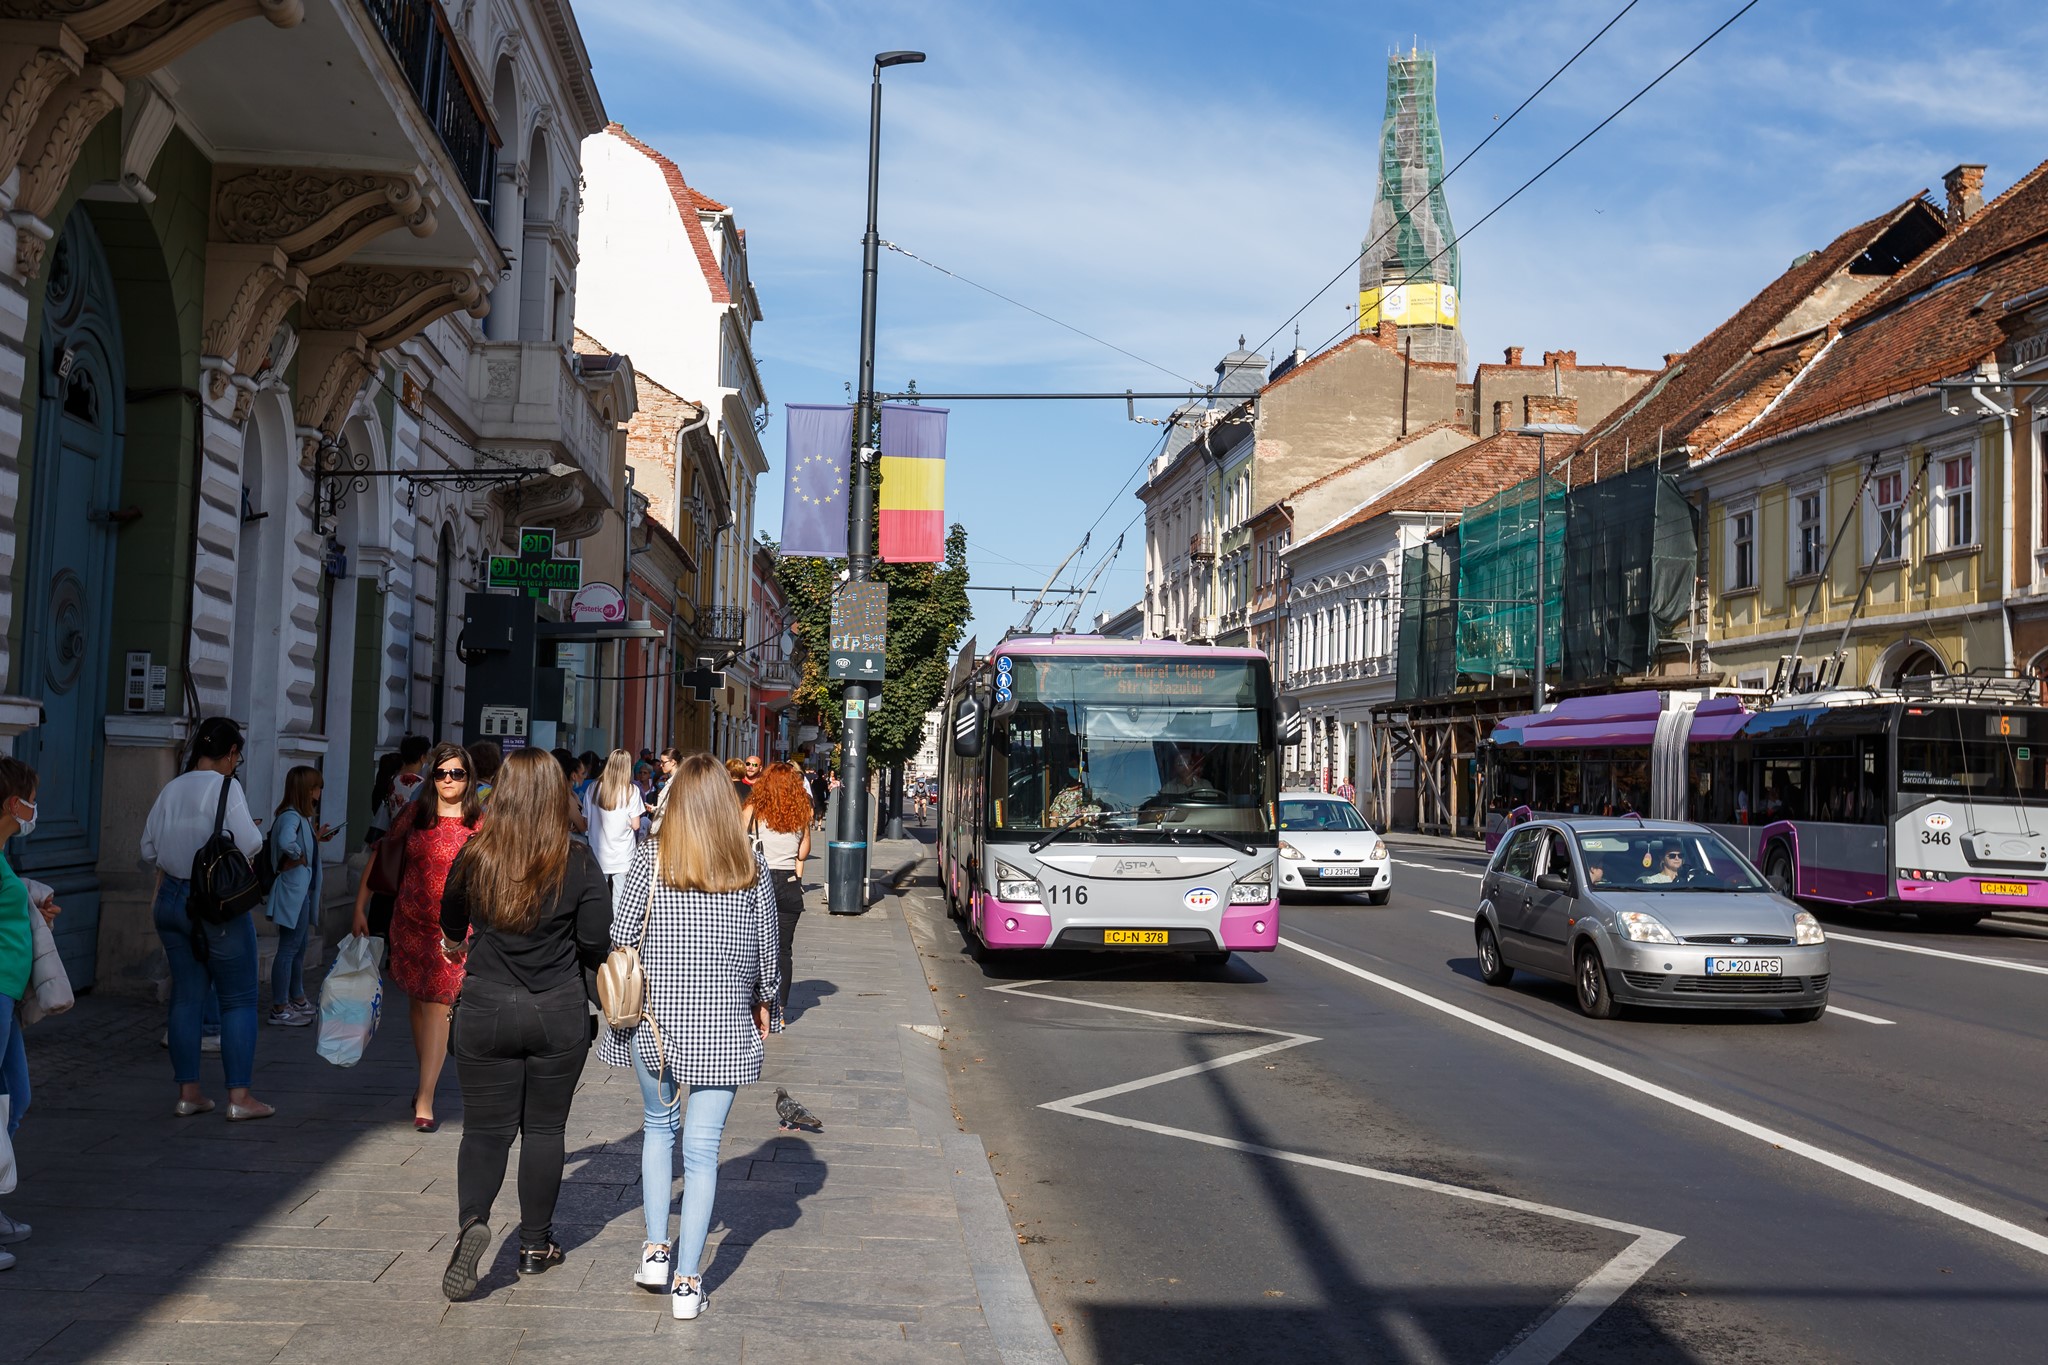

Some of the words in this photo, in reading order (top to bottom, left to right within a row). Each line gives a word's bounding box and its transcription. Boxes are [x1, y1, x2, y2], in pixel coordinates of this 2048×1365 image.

[506, 558, 579, 580] Ducfarm
[1037, 663, 1049, 692] 7
[1135, 663, 1169, 679] Aurel
[2000, 716, 2010, 736] 6
[1921, 831, 1951, 846] 346
[1324, 868, 1334, 876] CJ
[1335, 868, 1343, 876] 23
[1343, 868, 1358, 876] HCZ
[1048, 884, 1088, 905] 116
[2009, 885, 2023, 893] 429
[1112, 932, 1139, 942] CJ-N
[1144, 932, 1163, 942] 378
[1716, 960, 1732, 972] CJ
[1736, 960, 1751, 972] 20
[1754, 960, 1779, 972] ARS
